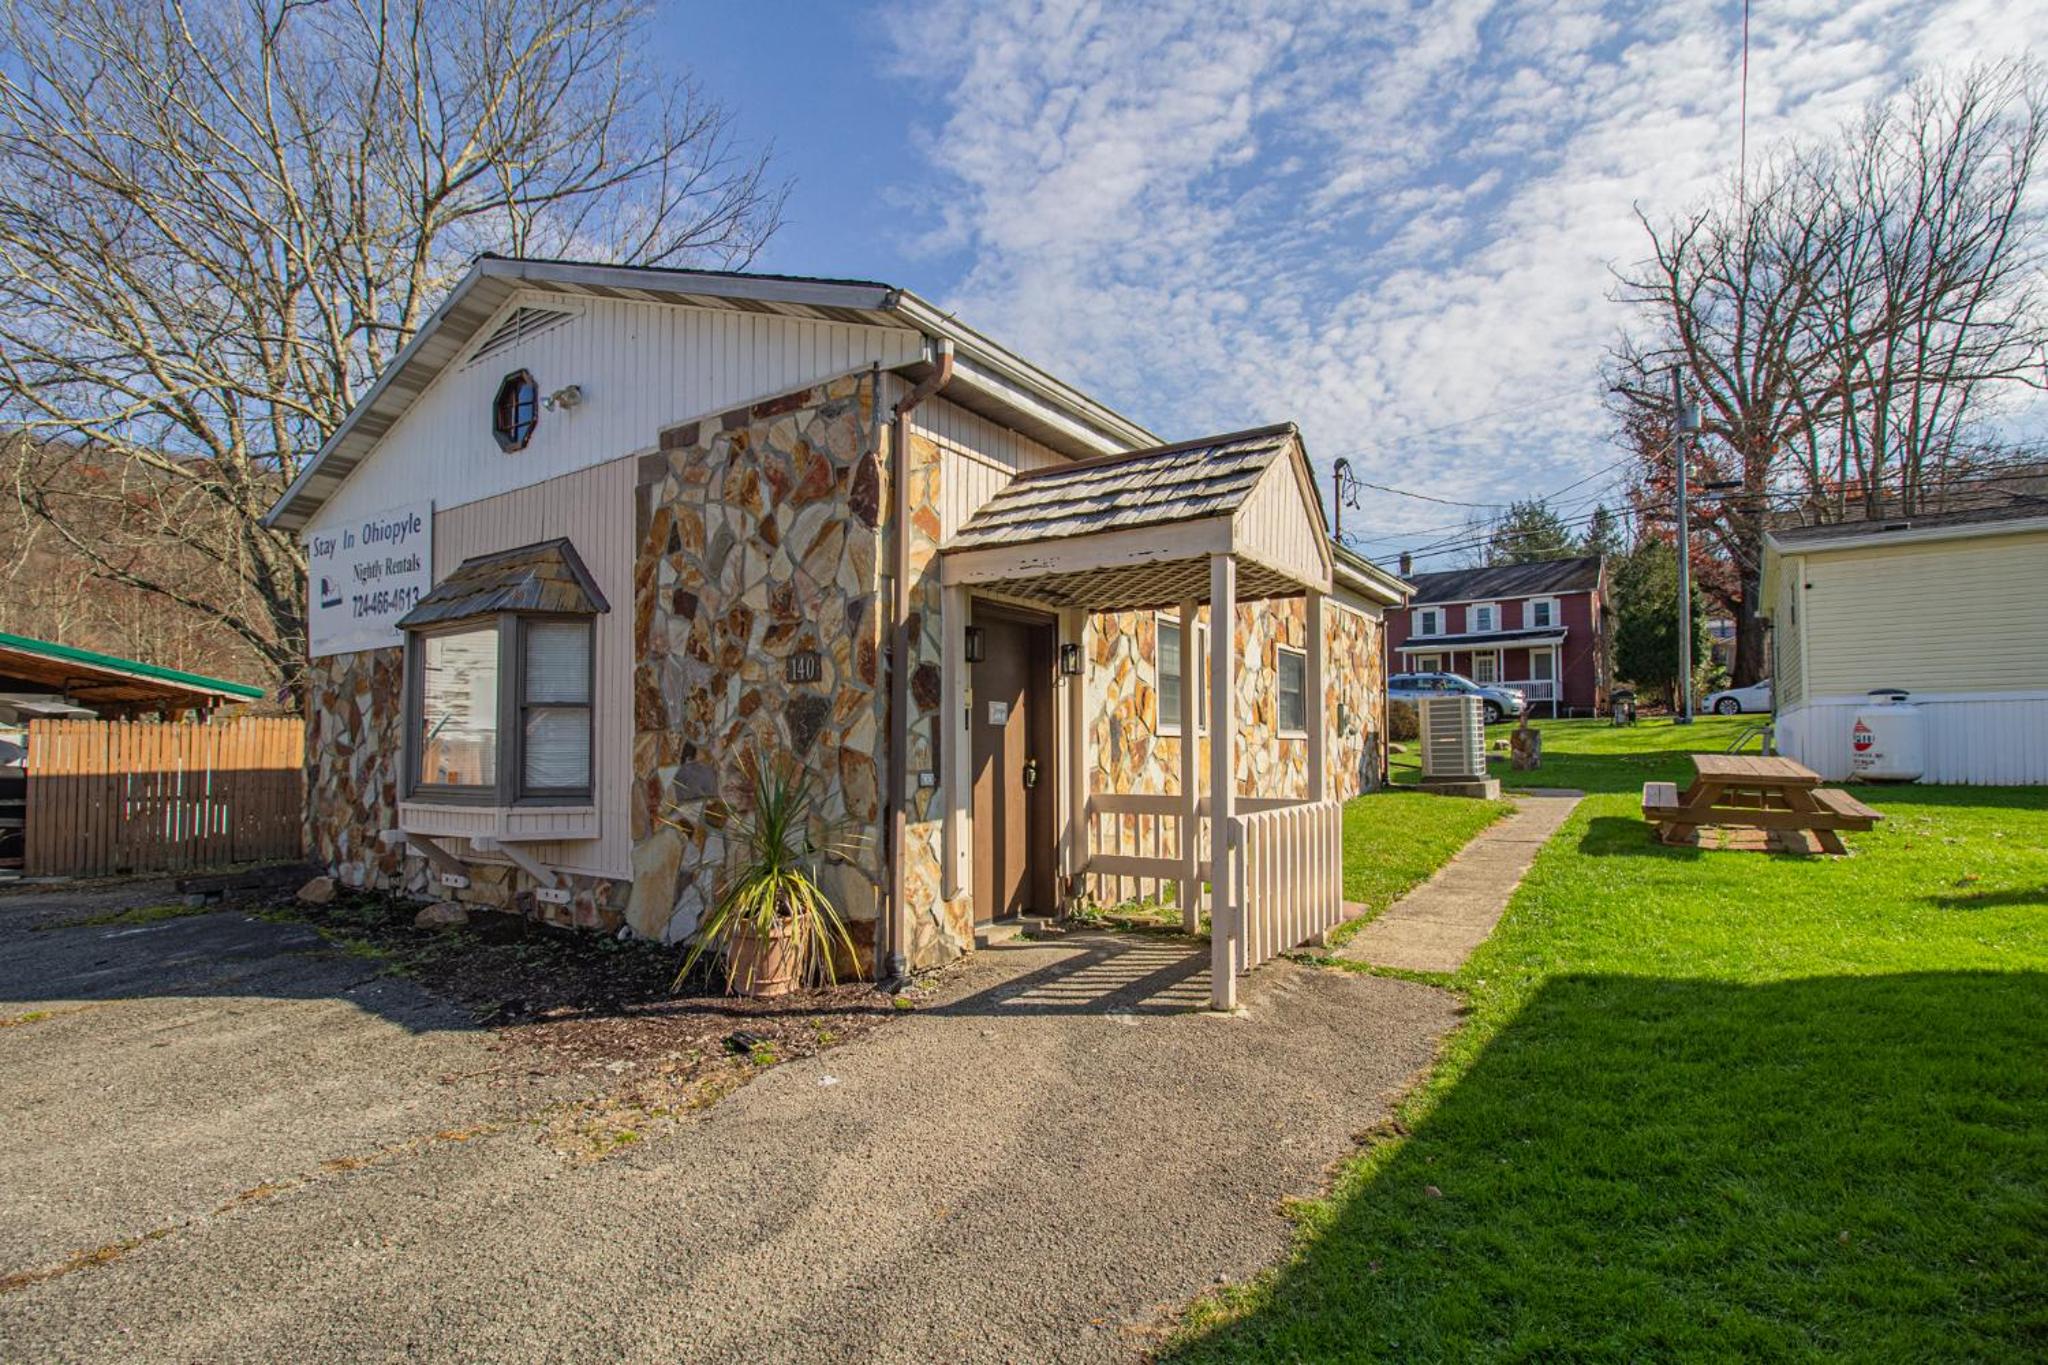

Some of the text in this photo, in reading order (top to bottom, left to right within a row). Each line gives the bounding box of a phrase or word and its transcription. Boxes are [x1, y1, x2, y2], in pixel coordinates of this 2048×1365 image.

[313, 512, 422, 560] Stay In Ohiopyle
[353, 552, 420, 586] Nightly Rentals
[792, 656, 815, 680] 140
